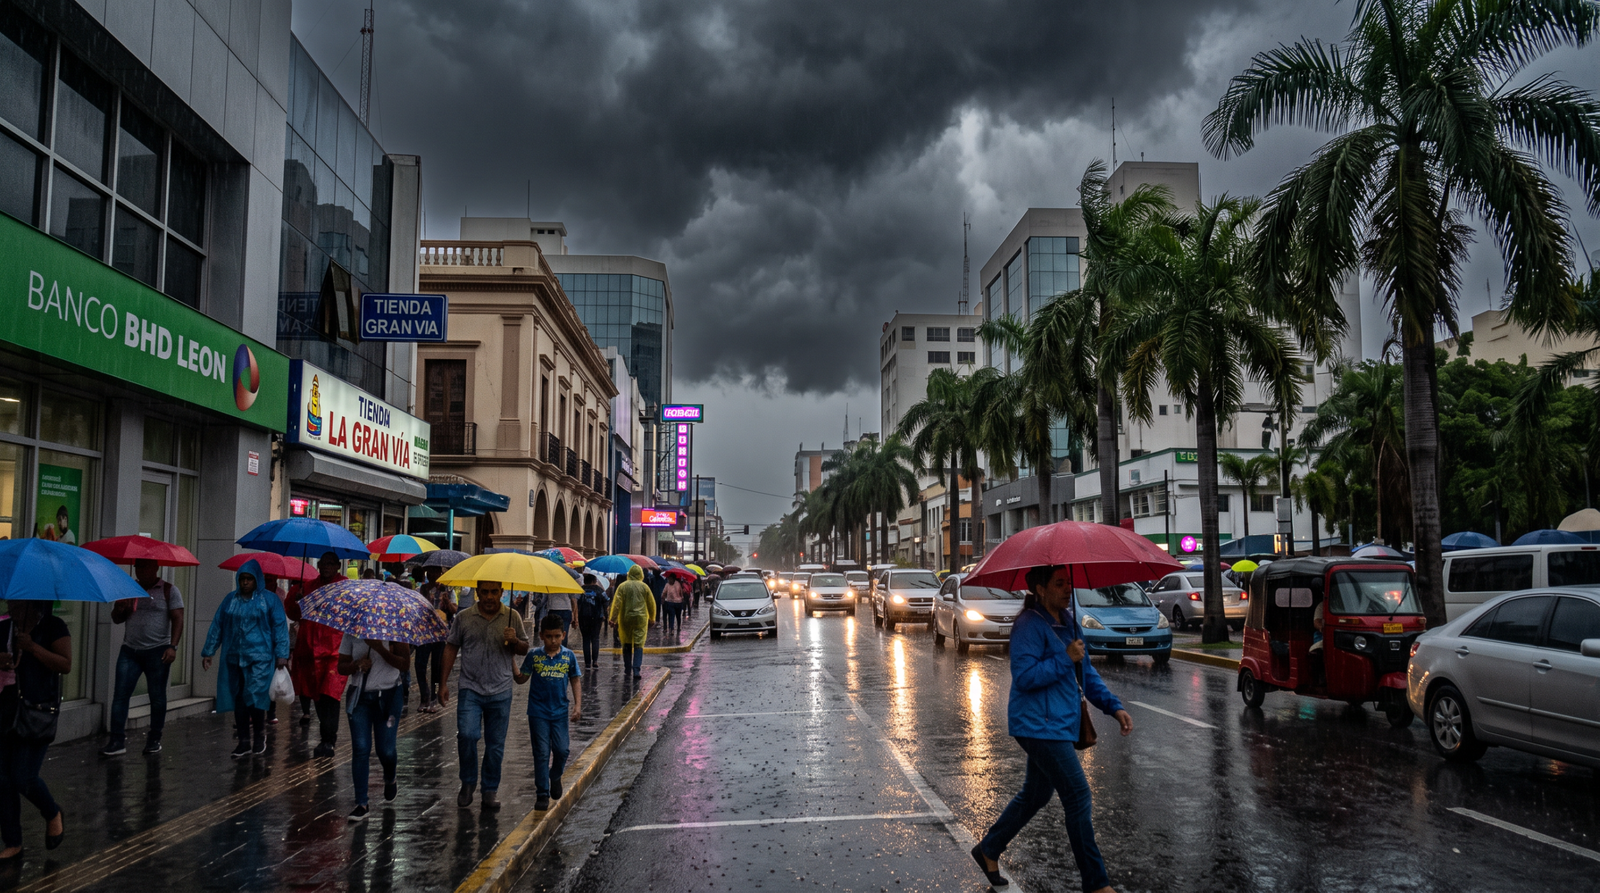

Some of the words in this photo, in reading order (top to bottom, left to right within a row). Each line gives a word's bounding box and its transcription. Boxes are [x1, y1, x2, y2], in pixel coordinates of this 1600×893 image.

[374, 299, 432, 315] TIENDA
[28, 270, 118, 339] BANCO
[124, 311, 173, 360] BHD
[177, 334, 226, 383] LEON
[365, 319, 412, 335] GRAN
[415, 320, 439, 335] VIA
[358, 395, 391, 429] TIENDA
[328, 411, 347, 449] LA
[352, 421, 389, 462] GRAN
[392, 432, 410, 469] VÍA
